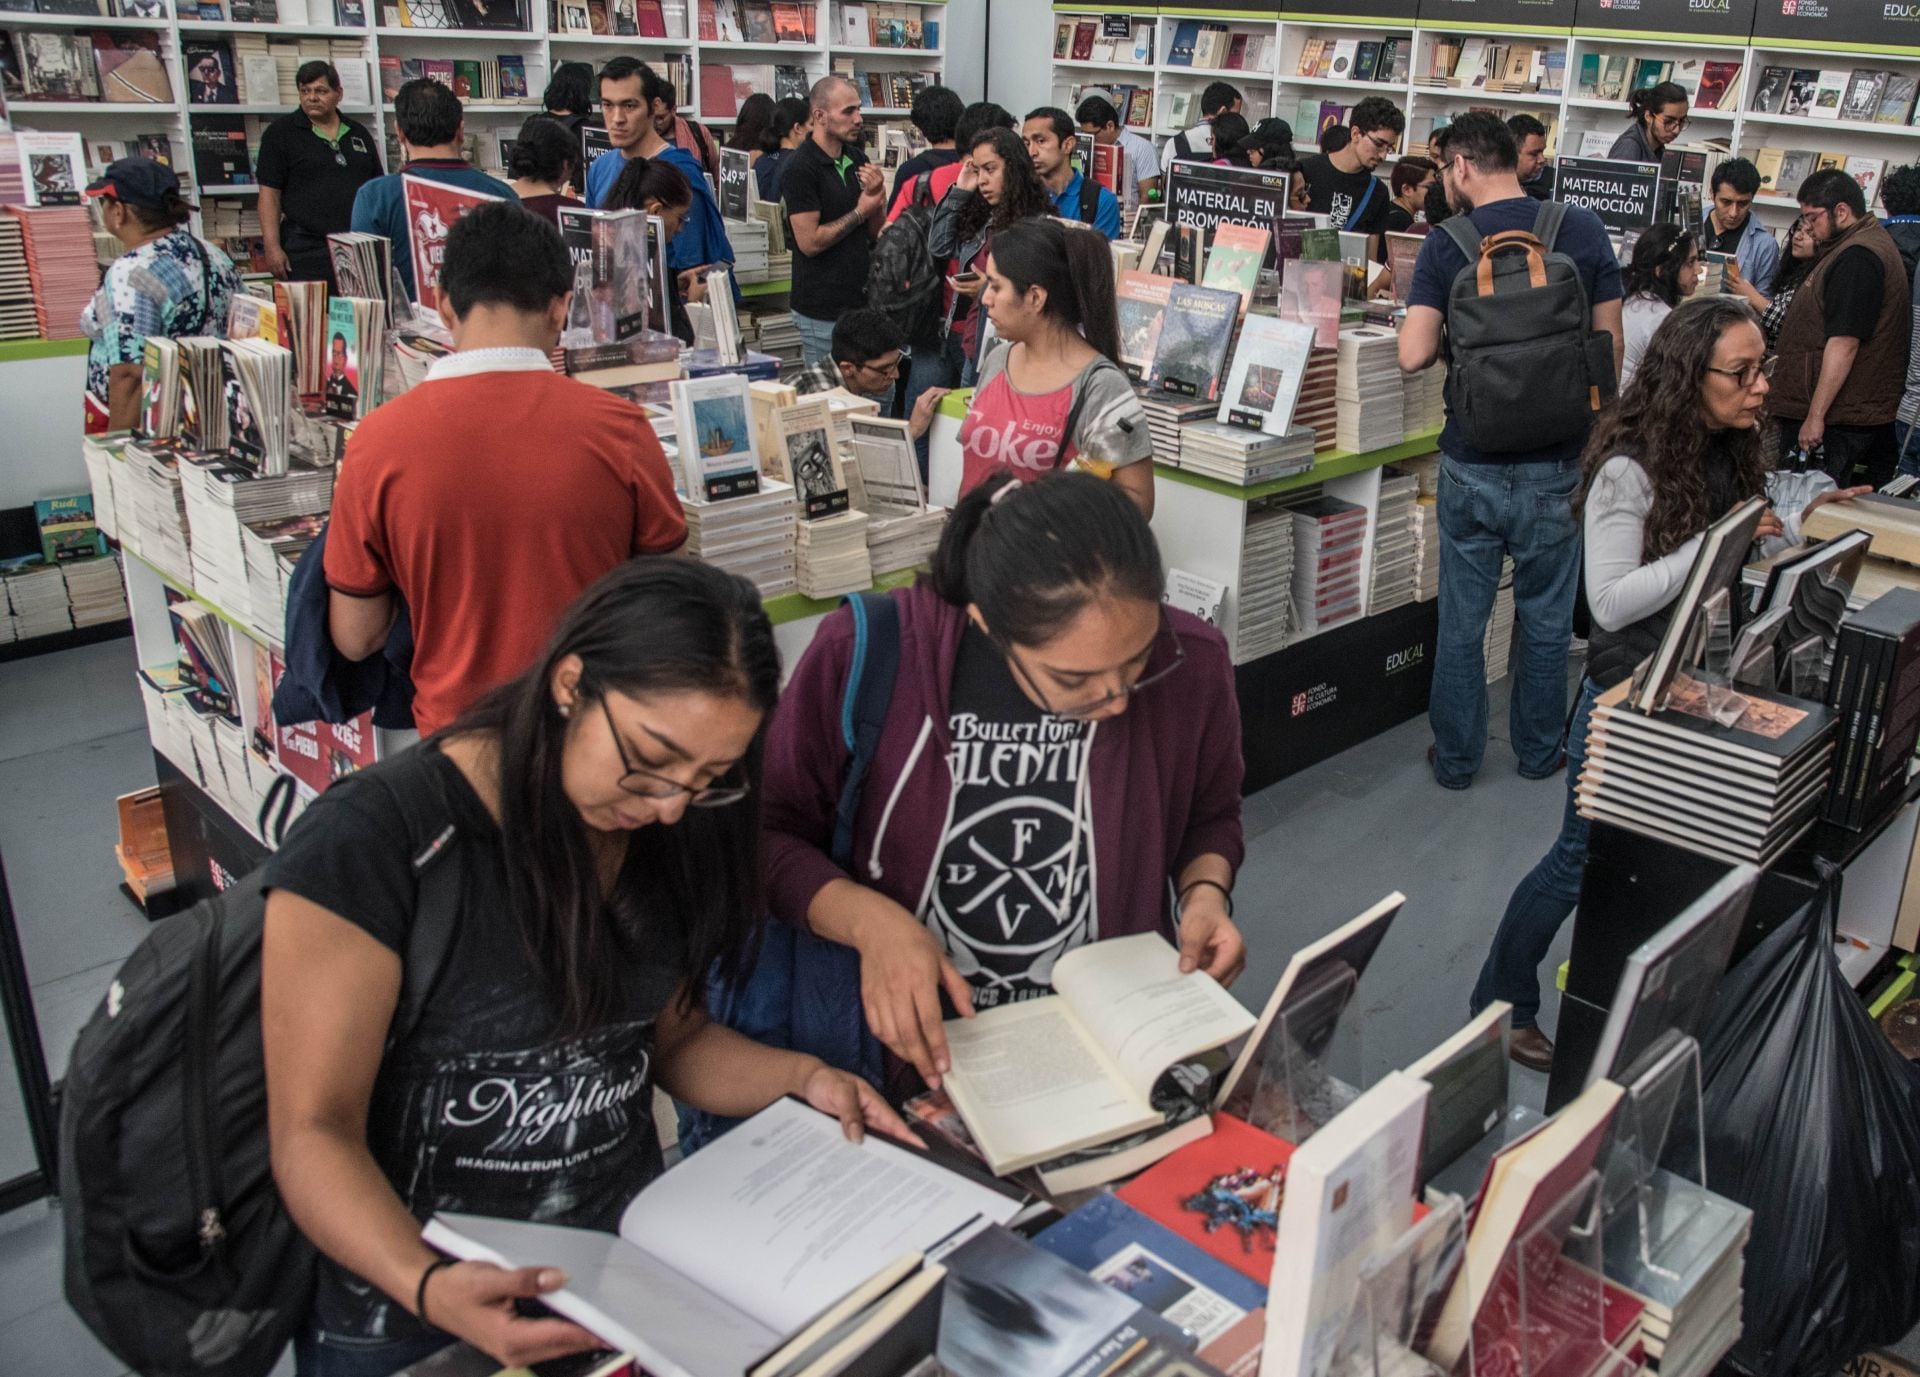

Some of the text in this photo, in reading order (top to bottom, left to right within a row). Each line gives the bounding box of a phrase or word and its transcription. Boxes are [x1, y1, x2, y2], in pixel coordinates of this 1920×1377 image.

[1689, 0, 1730, 9] EDUCAL
[1884, 4, 1920, 17] EDUC
[1562, 176, 1649, 198] MATERIAL EN
[1176, 187, 1275, 217] MATERIAL EN
[1563, 194, 1644, 216] PROMOCIÓN
[1176, 296, 1193, 307] LAS
[1195, 298, 1227, 313] MOSCAS
[1022, 419, 1062, 438] Enjoy
[1385, 643, 1424, 671] EDUCAL
[1307, 682, 1327, 696] FONDO
[1315, 686, 1338, 702] CULTURA
[949, 739, 1086, 788] ALENTI
[1010, 818, 1041, 862] F
[972, 986, 1000, 1006] NCE
[456, 1156, 563, 1172] IMAGINAERUM
[565, 1152, 590, 1167] LIVE
